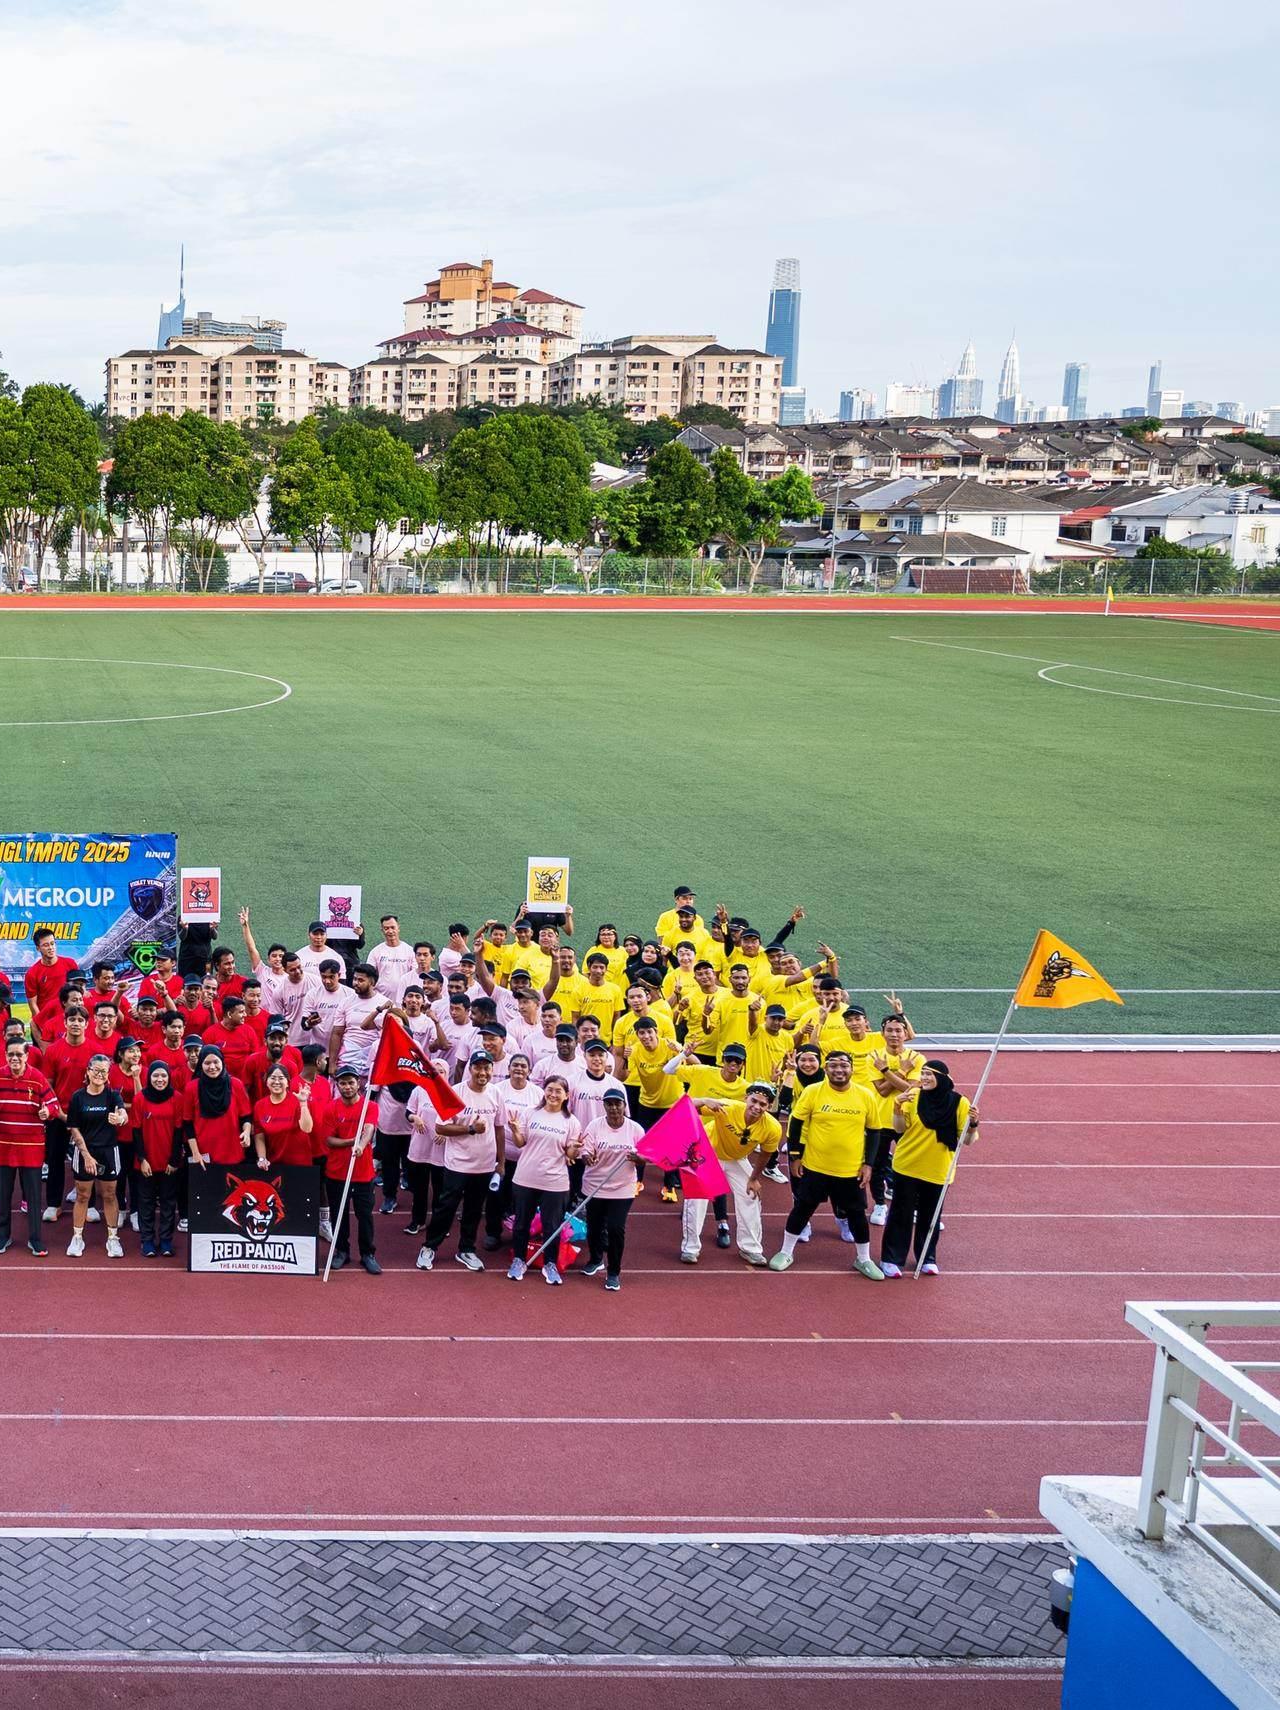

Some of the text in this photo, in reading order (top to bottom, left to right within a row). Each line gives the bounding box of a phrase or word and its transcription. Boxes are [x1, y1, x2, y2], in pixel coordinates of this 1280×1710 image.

[82, 841, 131, 863] 2025
[4, 887, 115, 907] MEGROUP
[539, 1125, 567, 1135] MEGROUP
[213, 1242, 295, 1262] RED PANDA
